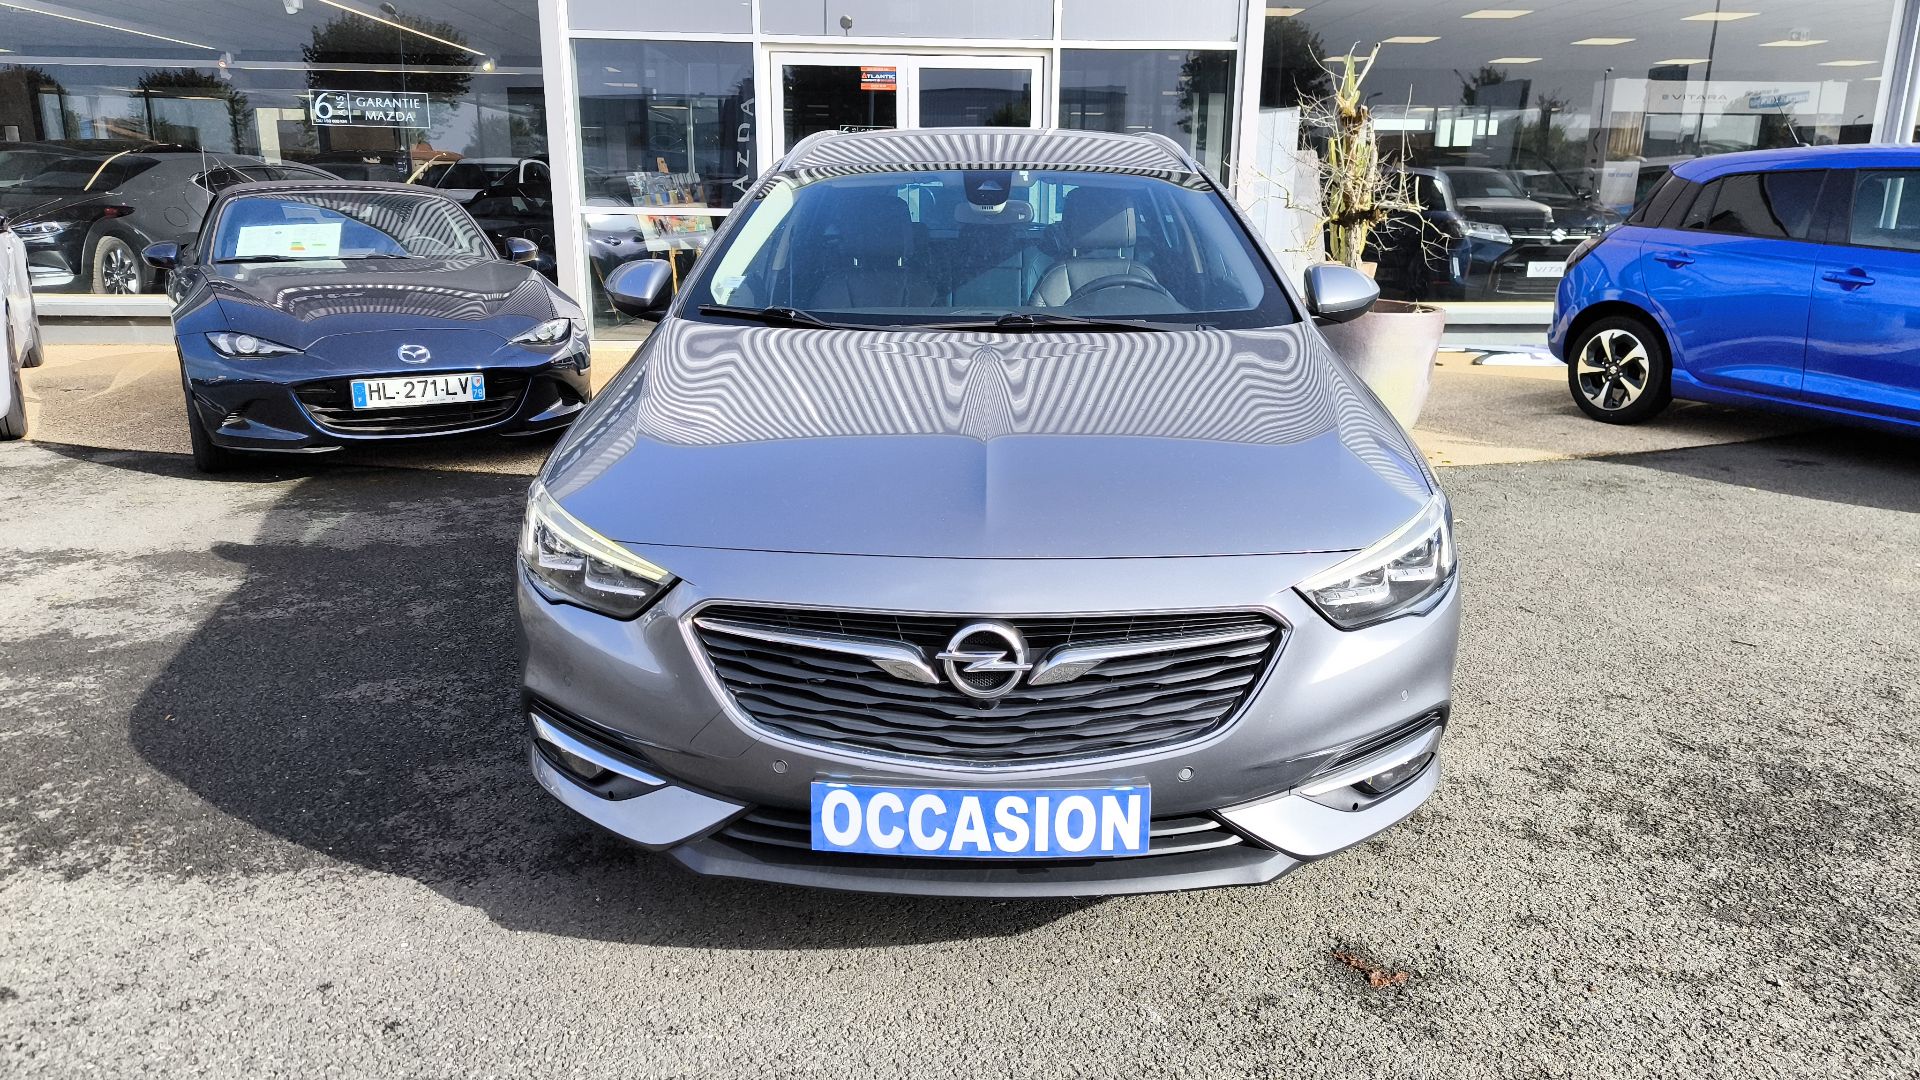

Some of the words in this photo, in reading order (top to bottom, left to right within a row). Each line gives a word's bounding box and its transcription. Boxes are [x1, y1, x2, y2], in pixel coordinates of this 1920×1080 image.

[315, 93, 332, 118] 6
[335, 95, 347, 116] ANS
[356, 97, 421, 109] GARANTIE
[365, 110, 414, 122] MAZDA
[731, 97, 756, 208] AZDA
[368, 376, 469, 401] HL-271-LV
[821, 789, 1142, 853] OCCASION
